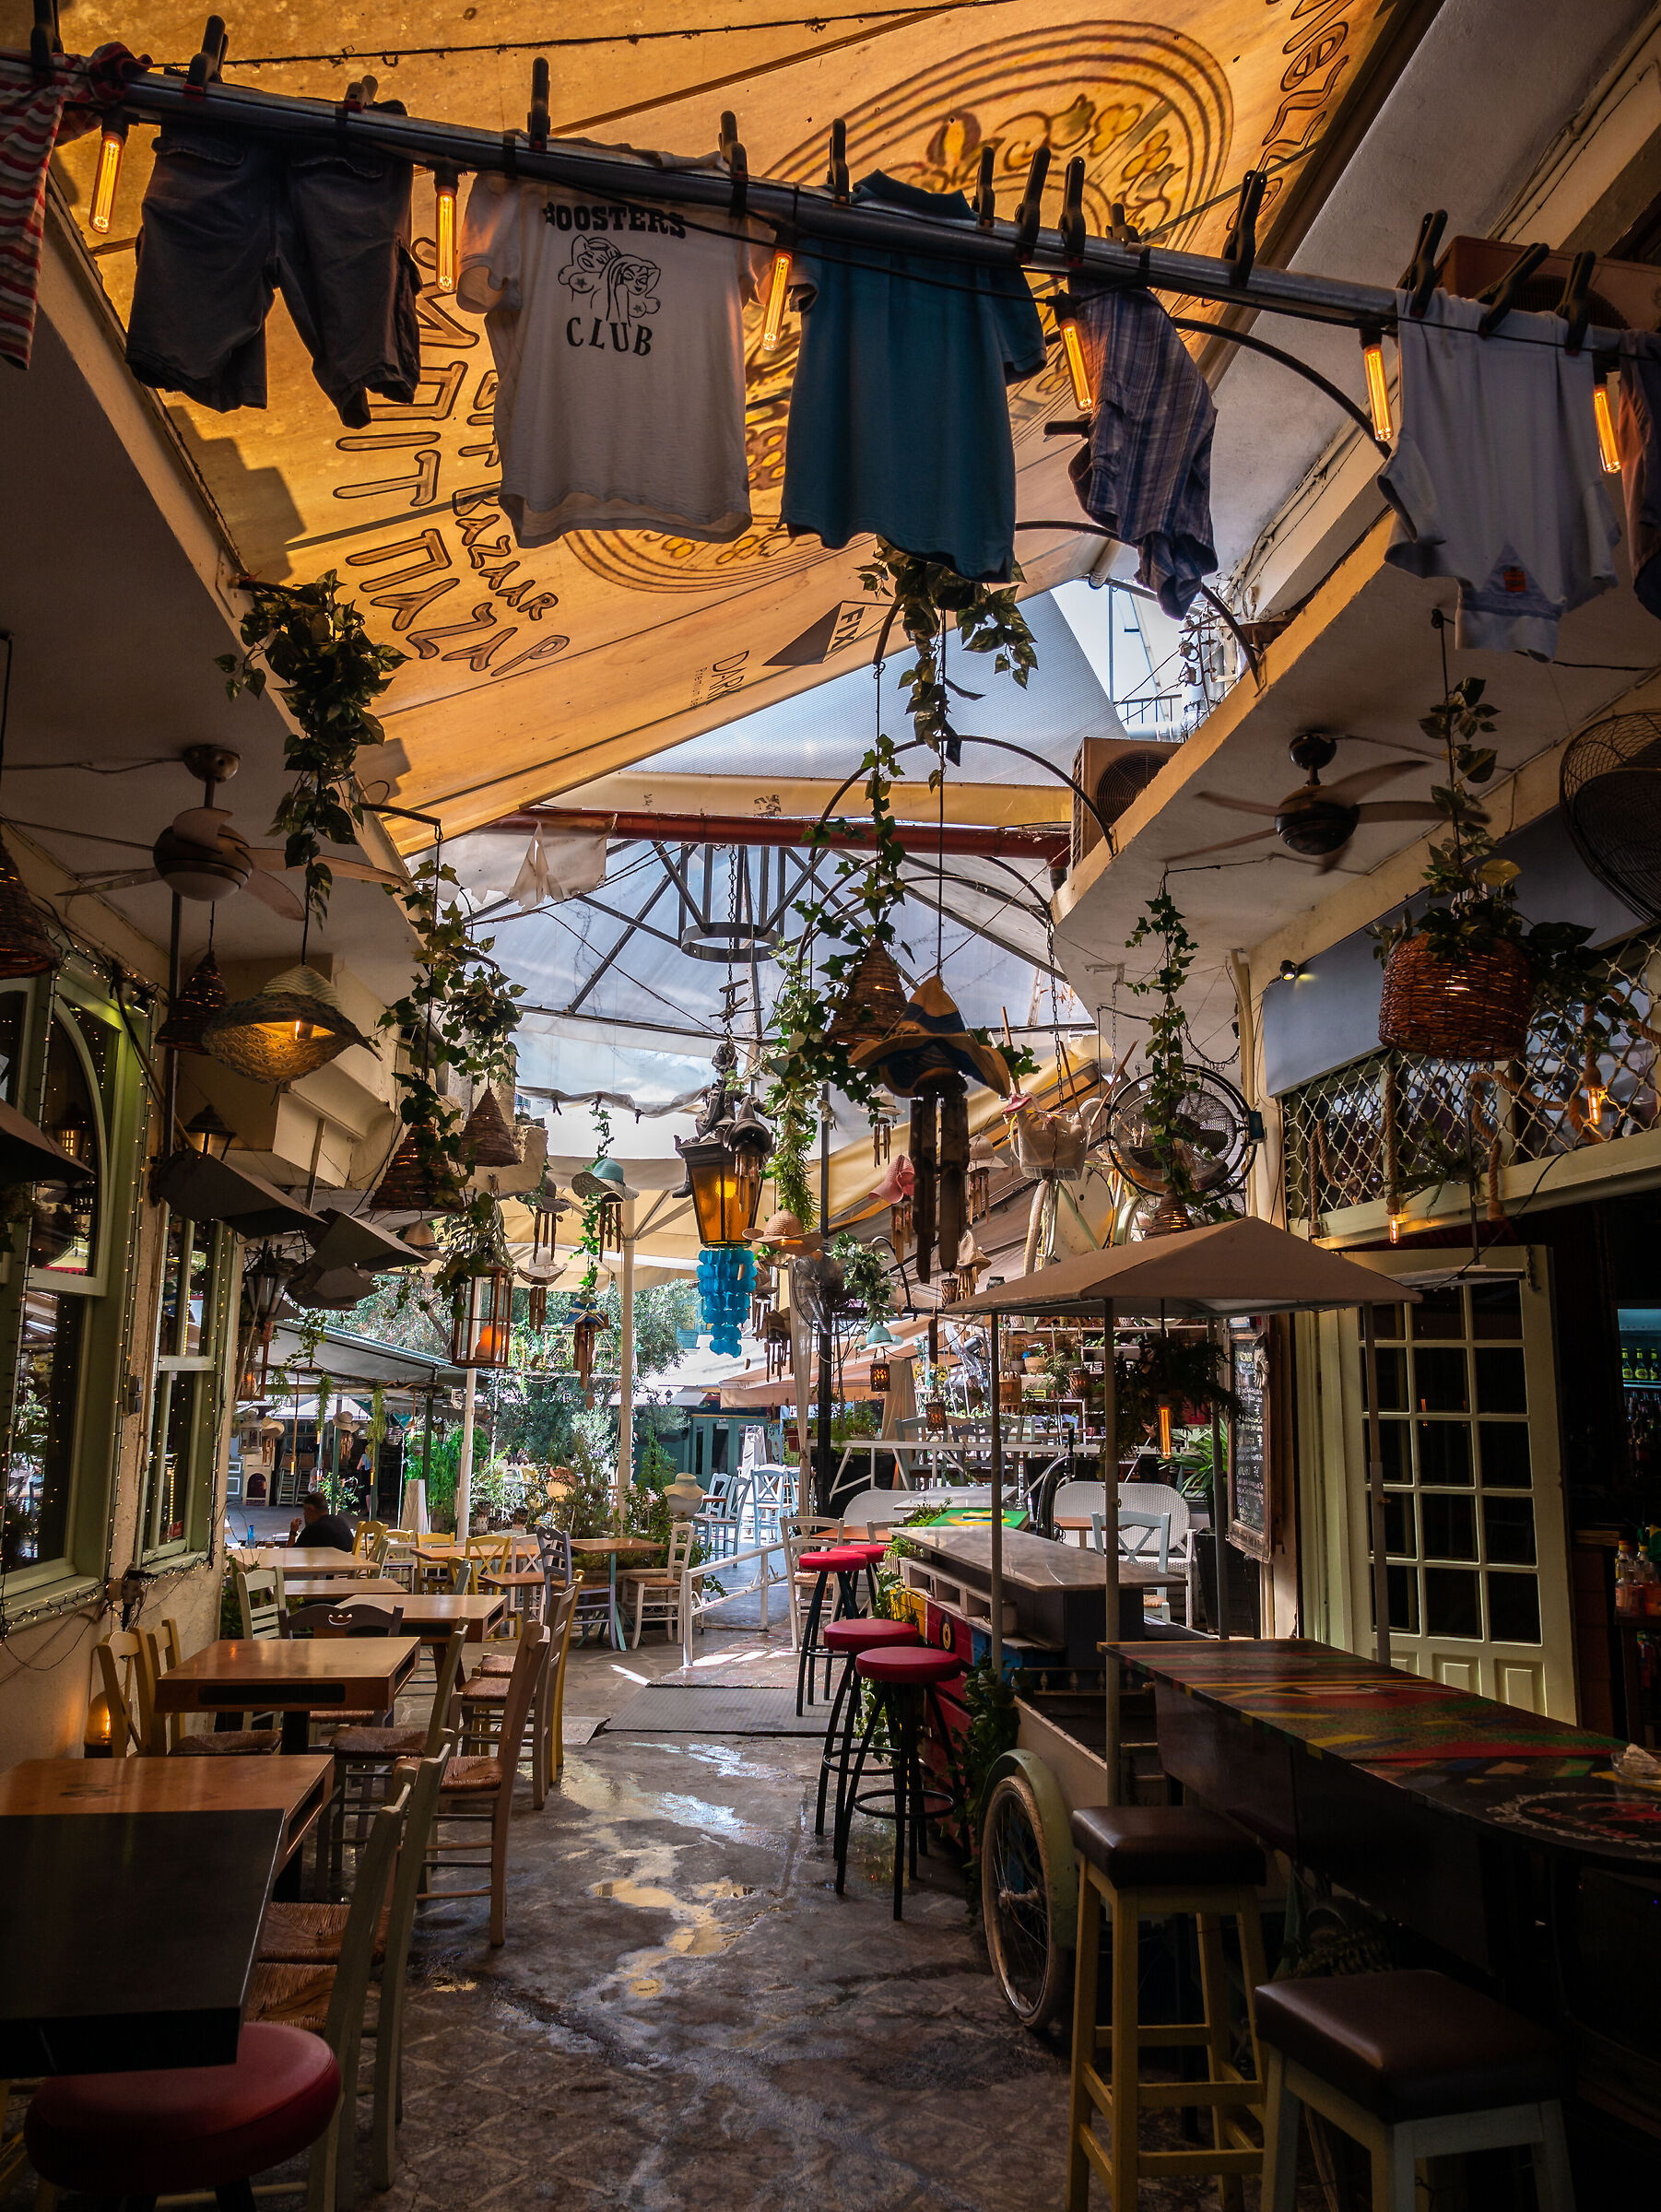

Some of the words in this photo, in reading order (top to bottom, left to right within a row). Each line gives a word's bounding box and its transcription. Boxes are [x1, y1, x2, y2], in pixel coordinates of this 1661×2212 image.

[566, 316, 654, 357] CLUB
[830, 606, 866, 652] FIX
[705, 649, 750, 706] DARK
